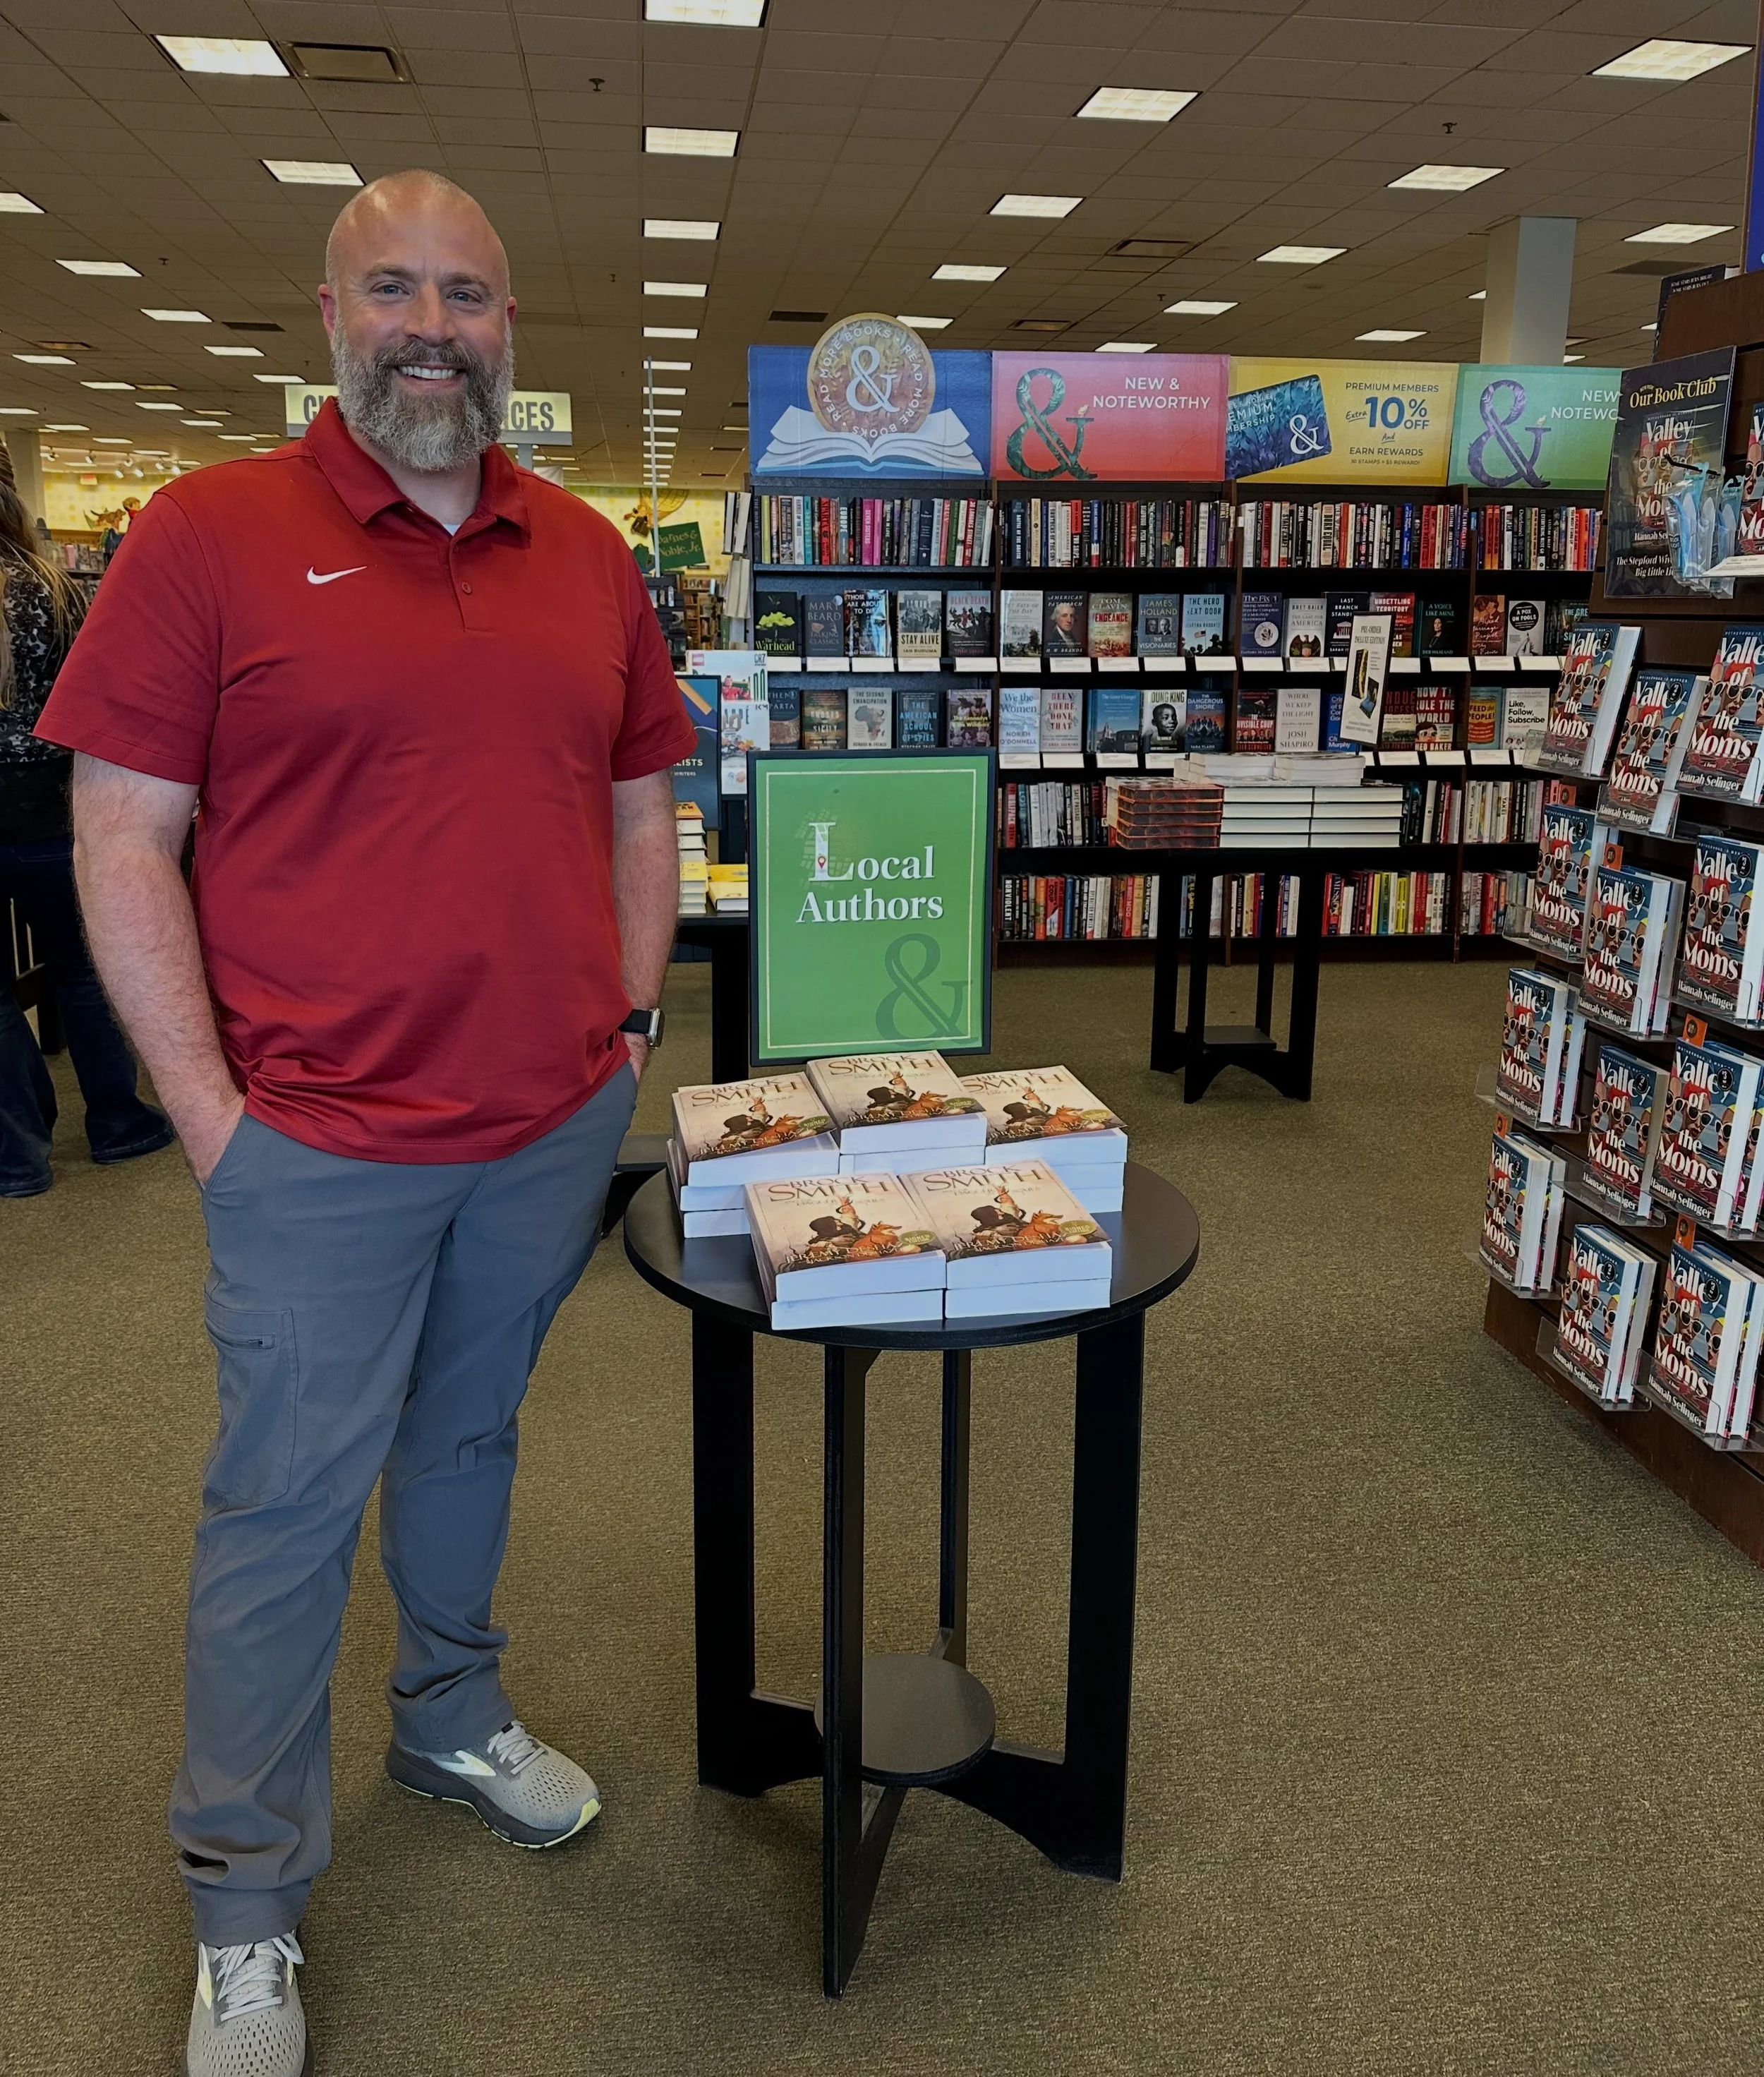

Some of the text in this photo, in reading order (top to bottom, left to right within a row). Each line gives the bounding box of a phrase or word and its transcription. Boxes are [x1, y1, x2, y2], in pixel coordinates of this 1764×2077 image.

[820, 326, 922, 438] READ MORE BOOKS READ MORE BOOKS
[846, 346, 900, 412] &
[1125, 377, 1180, 390] NEW &
[1346, 383, 1439, 392] PREMIUM MEMBERS
[1092, 395, 1210, 410] NOTEWORTHY
[1582, 390, 1619, 402] NEW
[1630, 377, 1717, 409] Our Book Club
[511, 402, 554, 431] CES
[1228, 402, 1274, 423] EMIUM
[1346, 411, 1367, 420] Extra
[1403, 419, 1430, 429] OFF
[1552, 407, 1618, 420] NOTEWO
[1226, 414, 1275, 433] MBERSHIP
[1646, 418, 1693, 443] Valley
[1382, 433, 1396, 441] And
[1377, 447, 1423, 457] REWARDS
[1654, 477, 1672, 495] the
[1322, 514, 1332, 550] BORN EQUAL
[1634, 531, 1657, 541] Hannah
[689, 542, 701, 552] Jr.
[1617, 555, 1657, 566] The Stepford
[1636, 566, 1668, 577] Big Little
[809, 602, 838, 610] MARY
[808, 612, 841, 621] BEARD
[1094, 613, 1128, 622] ENGEANCE
[756, 640, 795, 651] Warhead
[902, 634, 939, 645] STAY ALIVE
[1730, 667, 1751, 686] of
[1020, 693, 1034, 702] the
[1170, 692, 1184, 702] KING
[1636, 680, 1686, 714] Valley
[1001, 704, 1037, 713] Women
[1418, 713, 1450, 723] WORLD
[1643, 710, 1660, 726] of
[1260, 720, 1274, 728] COUP
[1712, 710, 1739, 731] the
[1689, 728, 1752, 760] Moms
[1629, 749, 1650, 769] the
[1608, 766, 1660, 796] Moms
[1679, 771, 1741, 792] Hannah Selinger
[1600, 805, 1650, 824] Hannah Selinger
[808, 821, 935, 881] Local
[795, 888, 943, 923] Authors
[1597, 877, 1646, 918] Valley
[1608, 910, 1621, 927] of
[1599, 948, 1621, 968] the
[1583, 959, 1634, 999] Moms
[1578, 997, 1628, 1026] Hannah Selinger
[828, 1059, 935, 1075] SMITH
[847, 1055, 915, 1064] BROCK
[712, 1079, 781, 1093] BROCK
[960, 1073, 1063, 1093] SMITH
[976, 1071, 1044, 1082] BROCK
[692, 1081, 797, 1107] SMITH
[1689, 1092, 1708, 1110] of
[1678, 1129, 1702, 1155] the
[943, 1164, 1020, 1178] BROCK
[1657, 1138, 1718, 1190] Moms
[790, 1176, 869, 1188] BROCK
[923, 1169, 1044, 1191] SMITH
[768, 1181, 889, 1202] SMITH
[1651, 1176, 1712, 1220] Hannah Selinger
[1670, 1254, 1722, 1315] Valley
[1681, 1298, 1698, 1317] of
[1672, 1332, 1693, 1361] the
[1655, 1340, 1708, 1397] Moms
[1649, 1374, 1703, 1427] Hannah Selinger
